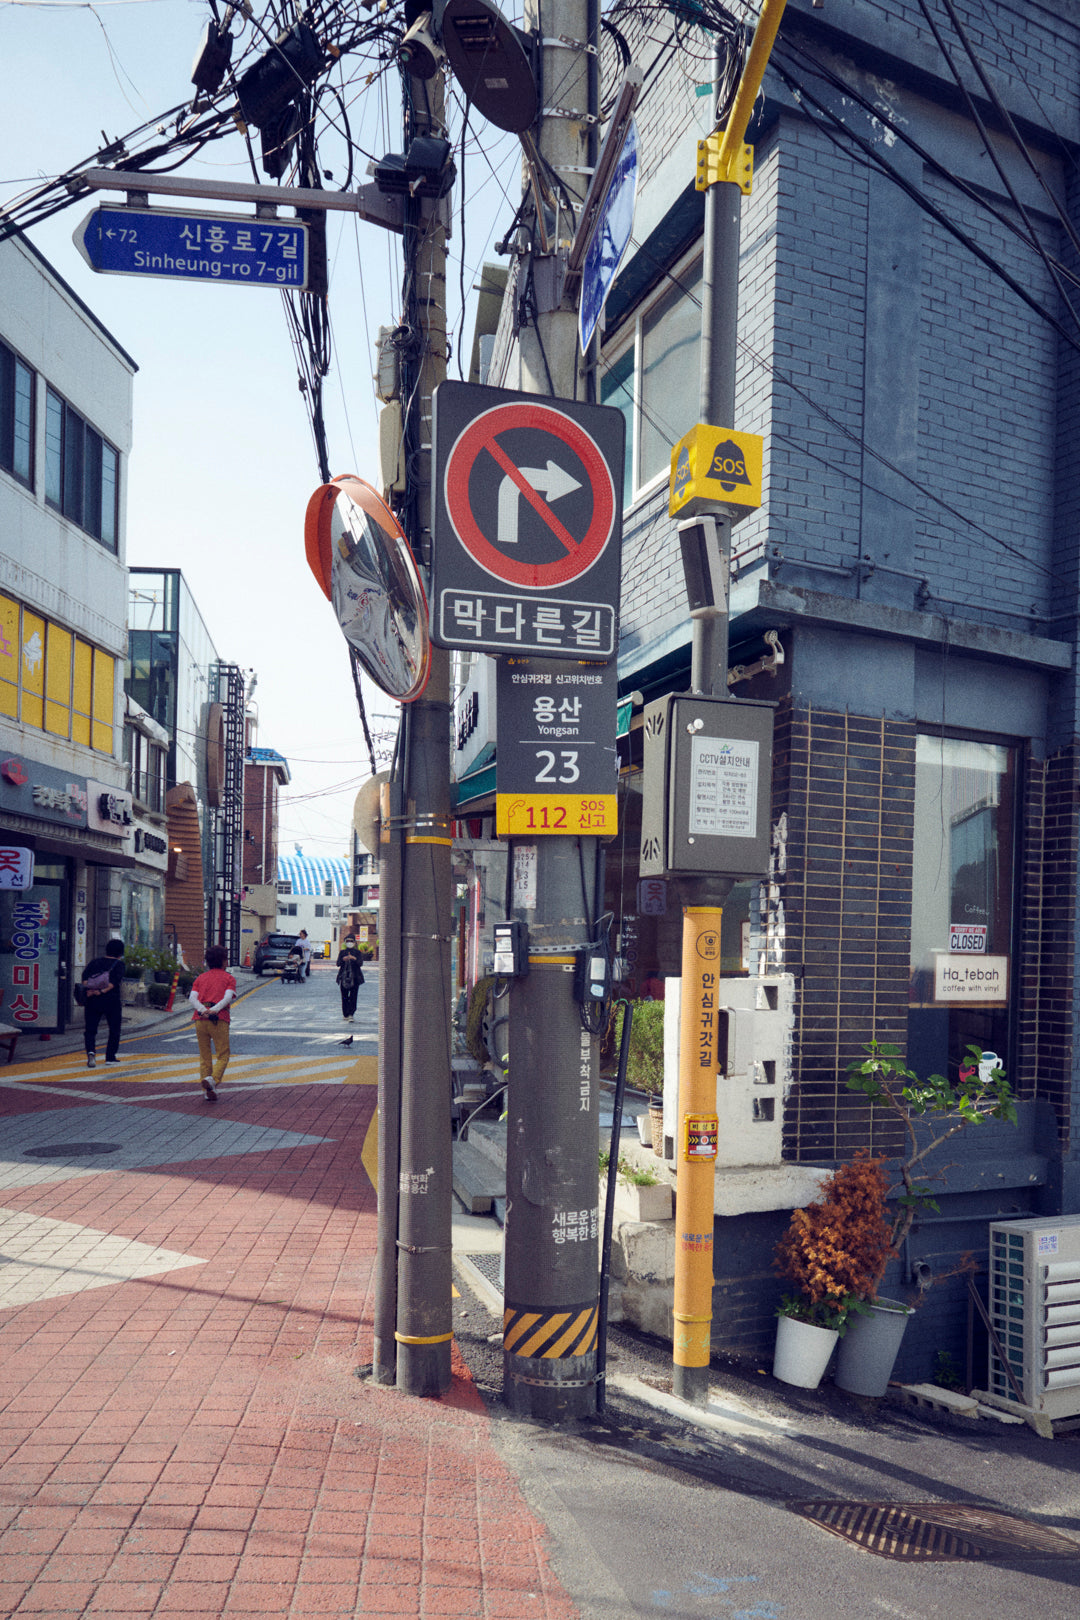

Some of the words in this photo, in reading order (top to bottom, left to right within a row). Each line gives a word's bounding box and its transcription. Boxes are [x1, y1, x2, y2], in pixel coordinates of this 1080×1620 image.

[118, 228, 138, 243] 72
[179, 224, 298, 259] 신흥로7길
[134, 251, 250, 277] Sinheung-ro
[256, 261, 298, 282] 7-gil
[713, 456, 744, 476] SOS
[454, 598, 602, 647] 막다른길
[511, 673, 552, 684] 안심귀갓길
[532, 696, 582, 723] 용산
[537, 725, 579, 737] Yongsan
[535, 750, 580, 784] 23
[526, 806, 568, 829] 112
[581, 800, 605, 812] SOS
[578, 814, 607, 829] 신고
[951, 934, 984, 950] CLOSED
[943, 967, 999, 982] Ha_tebah
[943, 984, 966, 992] coffee
[968, 984, 982, 992] with
[984, 984, 1000, 993] vinyl
[699, 973, 715, 1068] 안심귀갓길
[551, 1210, 589, 1227] 새로운
[551, 1225, 589, 1244] 행복한
